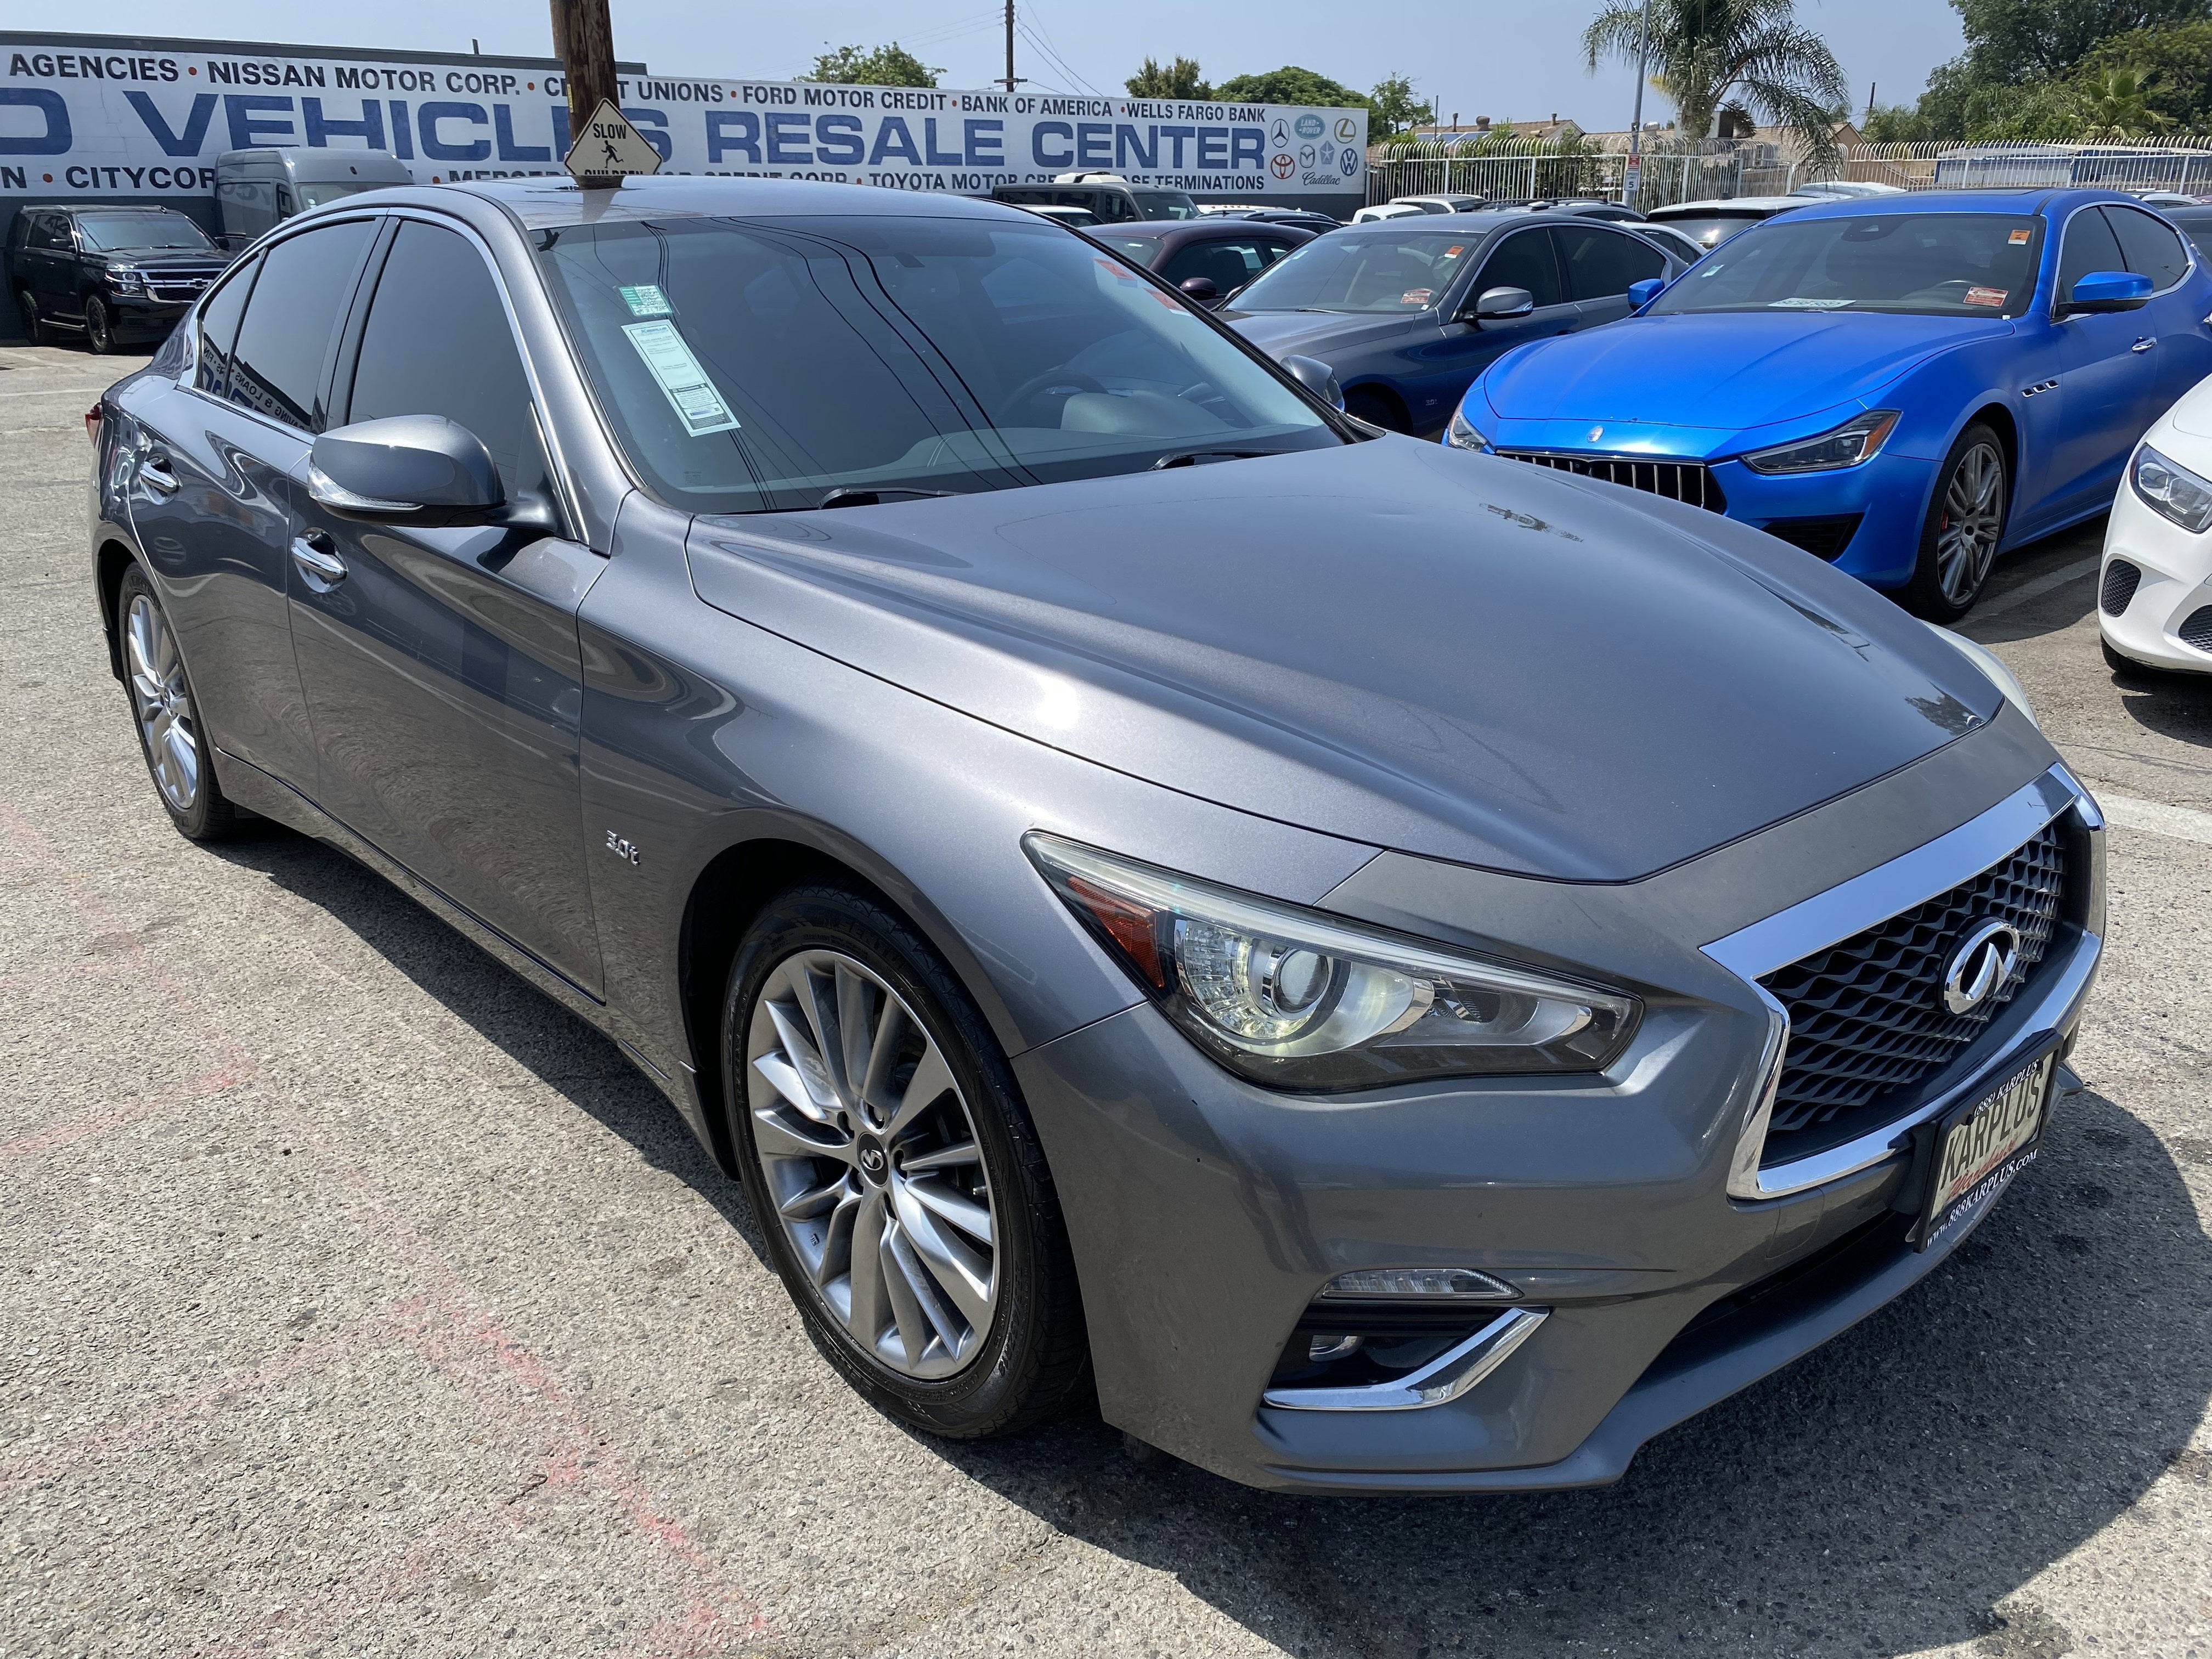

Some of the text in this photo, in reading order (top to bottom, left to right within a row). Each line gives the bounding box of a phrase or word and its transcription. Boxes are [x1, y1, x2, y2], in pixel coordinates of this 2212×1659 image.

[9, 53, 179, 82] AGENCIES
[207, 61, 326, 87] NISSAN
[335, 67, 437, 92] MOTOR
[446, 72, 520, 95] CORP.
[638, 81, 724, 103] UNIONS
[742, 86, 947, 111] FORD MOTOR CREDIT
[961, 95, 1113, 117] BANK OF AMERICA
[1126, 102, 1266, 123] WELLS FARGO BANK
[592, 123, 627, 139] SLOW
[705, 110, 1005, 166] RESALE
[1032, 121, 1265, 170] CENTER
[1301, 126, 1321, 134] ROVER
[65, 166, 216, 189] CITYCOR
[869, 172, 946, 190] TOYOTA
[952, 173, 1017, 190] MOTOR
[1155, 174, 1265, 190] TERMINATIONS
[1302, 172, 1341, 186] Cadillac
[1974, 1058, 2040, 1117] (888) KARPLUS
[1940, 1070, 2044, 1190] KARPLUS
